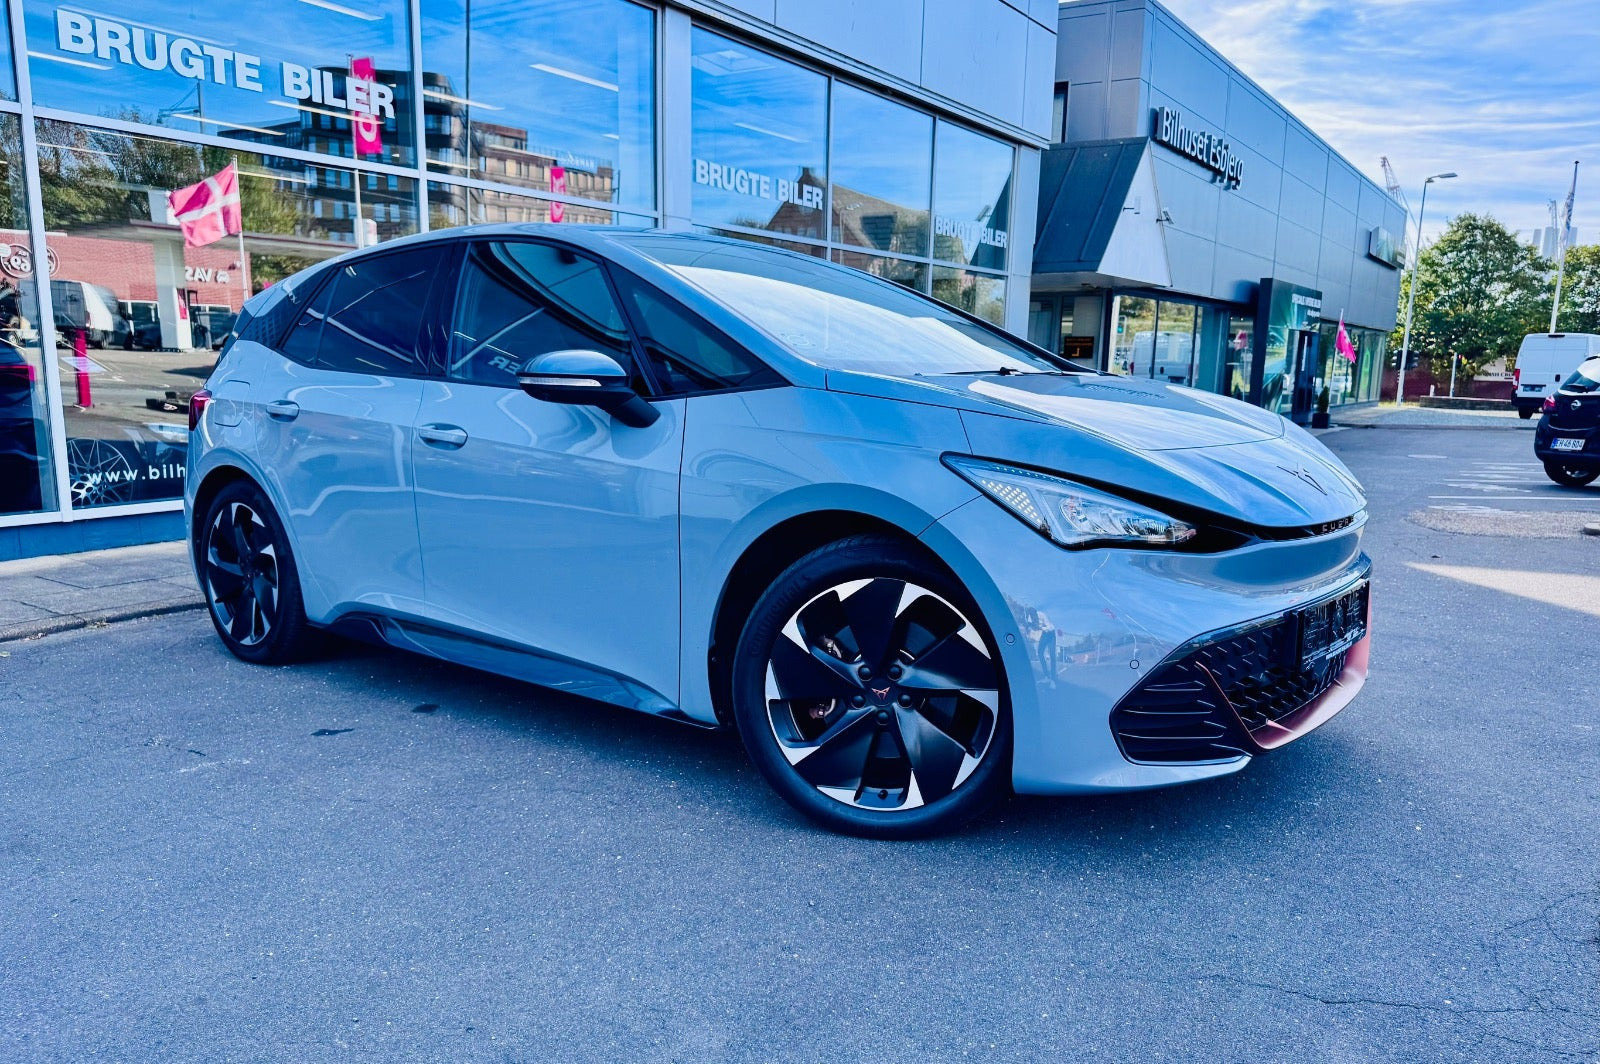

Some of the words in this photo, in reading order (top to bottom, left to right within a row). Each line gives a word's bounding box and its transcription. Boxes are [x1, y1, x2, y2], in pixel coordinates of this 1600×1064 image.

[56, 8, 263, 93] BRUGTE
[282, 60, 396, 119] BILER
[1162, 107, 1208, 163] Bilhuset
[1209, 136, 1244, 190] Esbjerg
[695, 158, 770, 200] BRUGTE
[778, 179, 823, 211] BILER
[980, 226, 1008, 249] BILER
